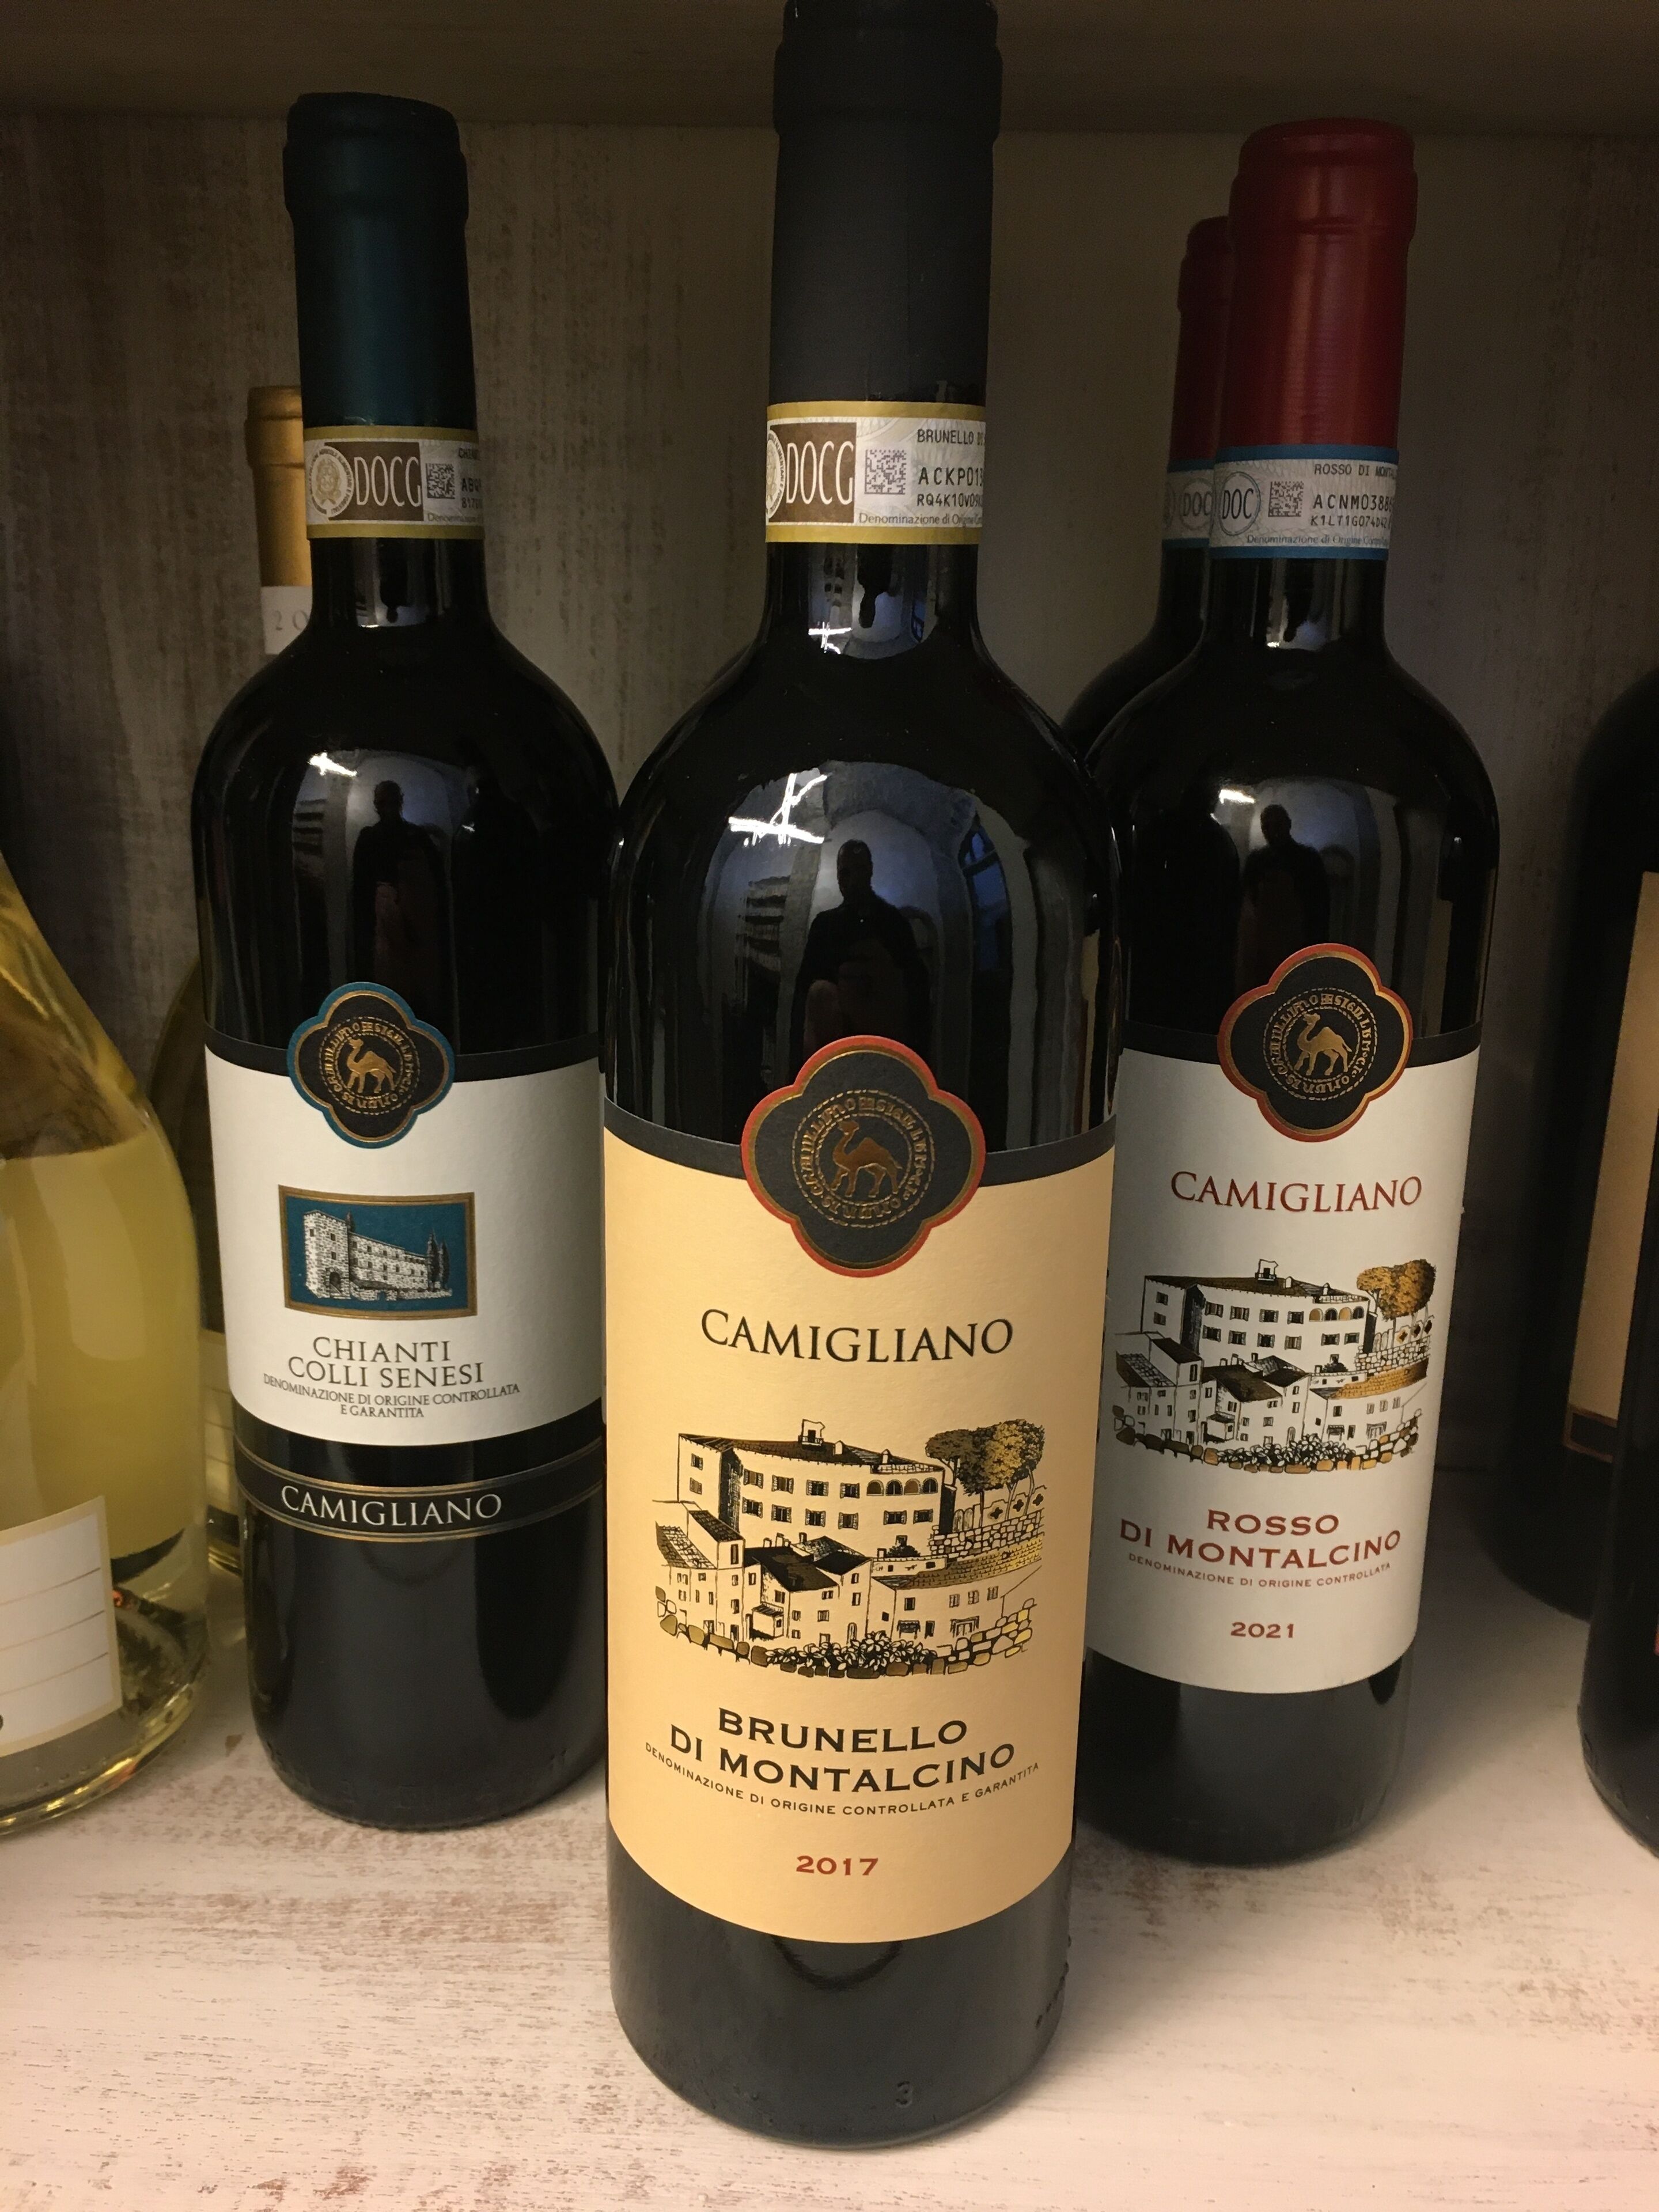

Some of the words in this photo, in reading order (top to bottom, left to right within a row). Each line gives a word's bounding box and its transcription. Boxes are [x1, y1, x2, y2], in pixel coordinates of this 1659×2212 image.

[917, 429, 974, 445] BRUNELLO
[354, 455, 422, 507] DOCG
[786, 441, 854, 505] DOCG
[1314, 463, 1353, 475] ROSSO
[1358, 464, 1370, 476] DI
[859, 512, 940, 525] Denominazione
[942, 513, 950, 524] di
[1222, 488, 1254, 519] DOC
[1247, 534, 1319, 544] Denominazione
[1321, 534, 1331, 544] di
[1171, 1171, 1422, 1212] CAMIGLIANO
[313, 1336, 452, 1363] CHIANTI
[701, 1308, 1013, 1363] CAMIGLIANO
[288, 1356, 369, 1388] COLLI
[380, 1361, 484, 1389] SENESI
[263, 1373, 354, 1404] DENOMINAZIONE
[358, 1394, 372, 1405] DI
[374, 1395, 430, 1406] ORIGINE
[433, 1383, 520, 1405] CONTROLLATA
[341, 1406, 347, 1415] E
[350, 1407, 425, 1418] GARANTITA
[281, 1485, 502, 1527] CAMIGLIANO
[1207, 1509, 1339, 1536] ROSSO
[1119, 1518, 1152, 1548] DI
[1167, 1529, 1401, 1569] MONTALCINO
[1128, 1552, 1234, 1585] DENOMINAZIONE
[1240, 1578, 1253, 1586] DI
[1259, 1579, 1312, 1588] ORIGINE
[1316, 1562, 1391, 1586] CONTROLLATA
[1230, 1622, 1295, 1639] 2021
[718, 1707, 967, 1753] BRUNELLO
[670, 1724, 703, 1762] DI
[719, 1743, 1015, 1793] MONTALCINO
[645, 1741, 744, 1800] DENOMINAZIONE
[750, 1794, 765, 1805] DI
[771, 1798, 836, 1815] ORIGINE
[843, 1797, 955, 1815] CONTROLLATA
[961, 1792, 969, 1802] E
[975, 1762, 1040, 1798] GARANTITA
[796, 1855, 879, 1876] 2017
[894, 2080, 914, 2109] 3
